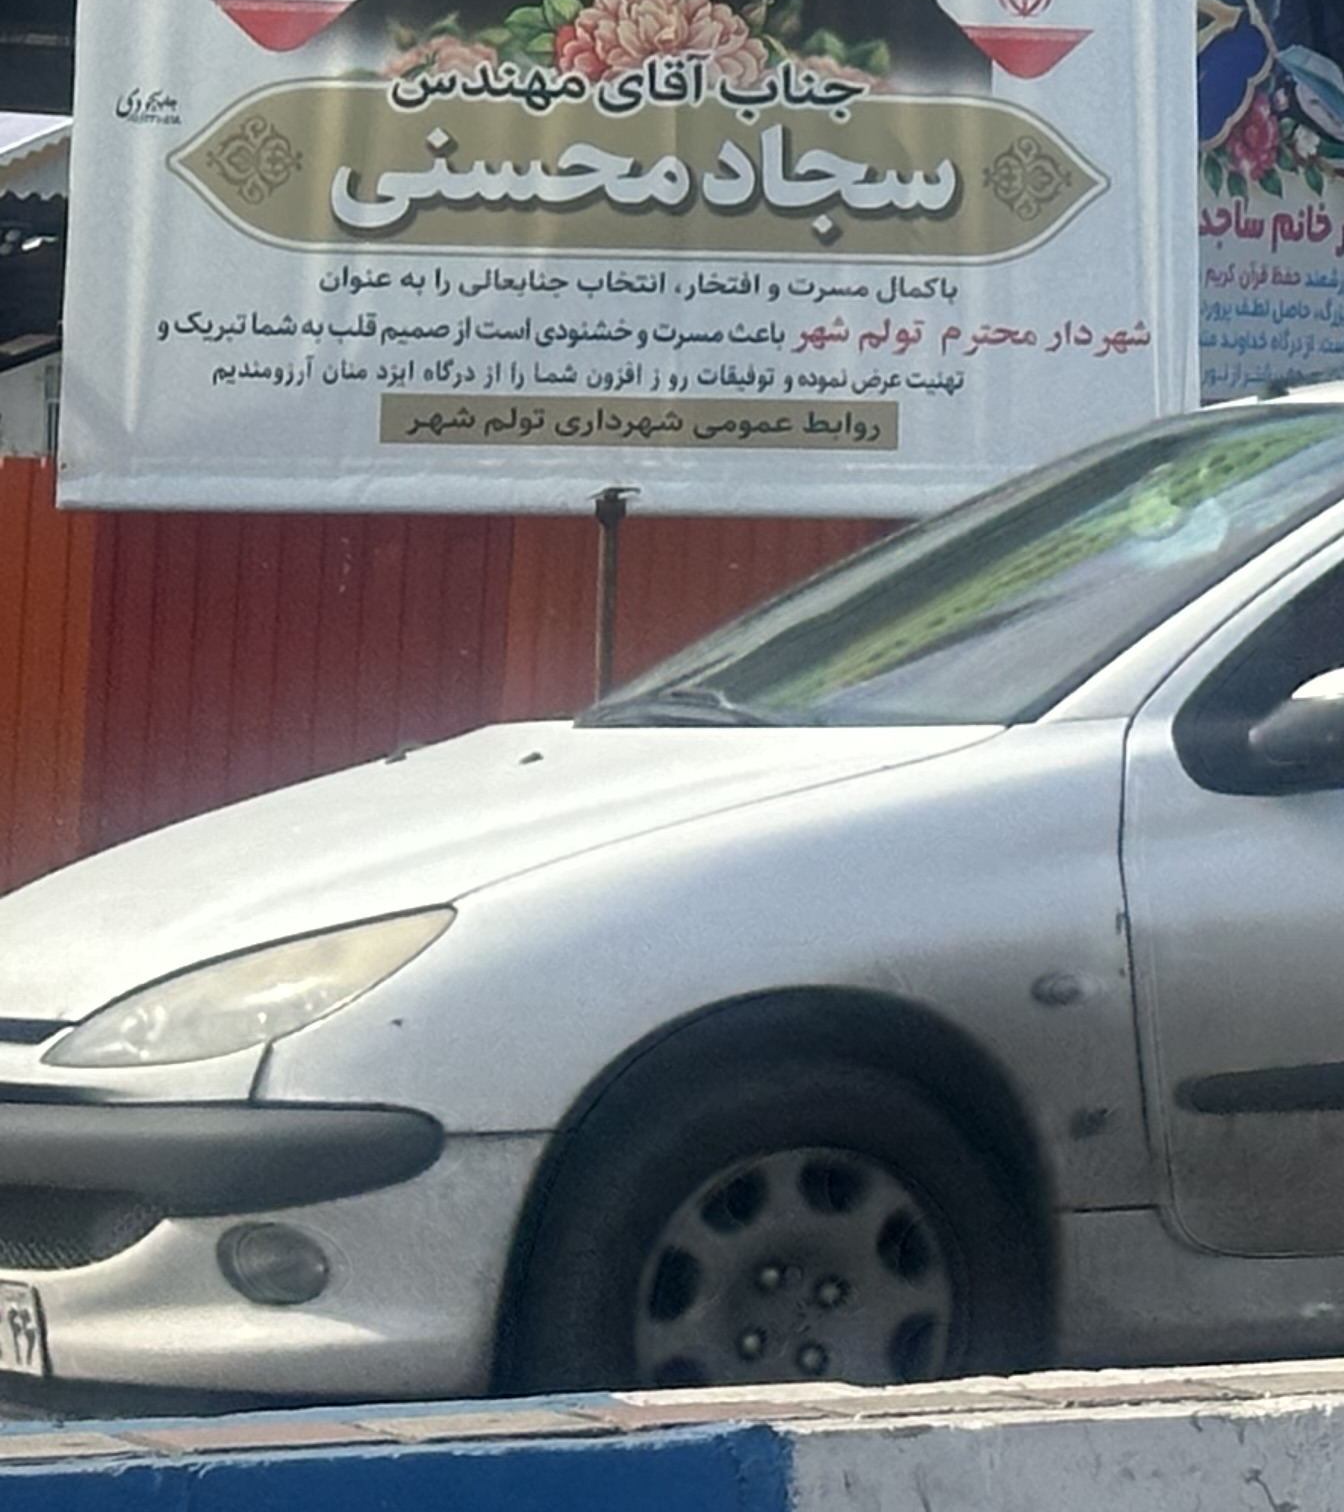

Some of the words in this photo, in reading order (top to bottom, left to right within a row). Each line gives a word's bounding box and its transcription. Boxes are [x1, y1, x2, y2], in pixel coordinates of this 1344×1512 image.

[390, 62, 586, 113] مهندس
[599, 56, 704, 114] آقای
[720, 63, 867, 122] جناب
[330, 127, 691, 230] محسنی
[701, 124, 957, 236] سجاد
[1271, 201, 1331, 253] خانم
[319, 266, 391, 294] عنوان
[400, 271, 426, 296] به
[436, 268, 450, 296] را
[459, 269, 568, 298] جنابعالی
[577, 271, 665, 299] انتخاب
[768, 281, 780, 300] و
[788, 276, 868, 303] مسرت
[157, 320, 168, 340] و
[174, 312, 246, 342] تبریک
[252, 312, 297, 336] شما
[302, 319, 324, 345] به
[328, 312, 377, 345] قلب
[381, 322, 450, 345] صمیم
[453, 316, 471, 345] از
[475, 319, 531, 340] است
[536, 320, 632, 347] خشنودی
[637, 327, 648, 347] و
[653, 323, 723, 350] مسرت
[727, 322, 785, 350] باعث
[792, 316, 849, 352] شهر
[858, 319, 924, 354] تولم
[941, 322, 1037, 356] محترم
[1044, 321, 1151, 356] شهردار
[212, 355, 314, 386] آرزومندیم
[322, 359, 367, 385] منان
[377, 360, 413, 387] ایزد
[424, 359, 475, 387] درگاه
[486, 361, 501, 388] از
[511, 361, 524, 389] را
[534, 362, 577, 384] شما
[587, 363, 642, 390] افزون
[697, 364, 775, 392] توفیقات
[784, 374, 793, 392] و
[798, 372, 847, 392] نموده
[852, 372, 901, 394] عرض
[906, 370, 965, 394] تهنیت
[406, 407, 476, 436] شهر
[484, 407, 545, 437] تولم
[554, 408, 683, 437] شهرداری
[693, 412, 793, 439] عمومی
[803, 410, 880, 441] روابط
